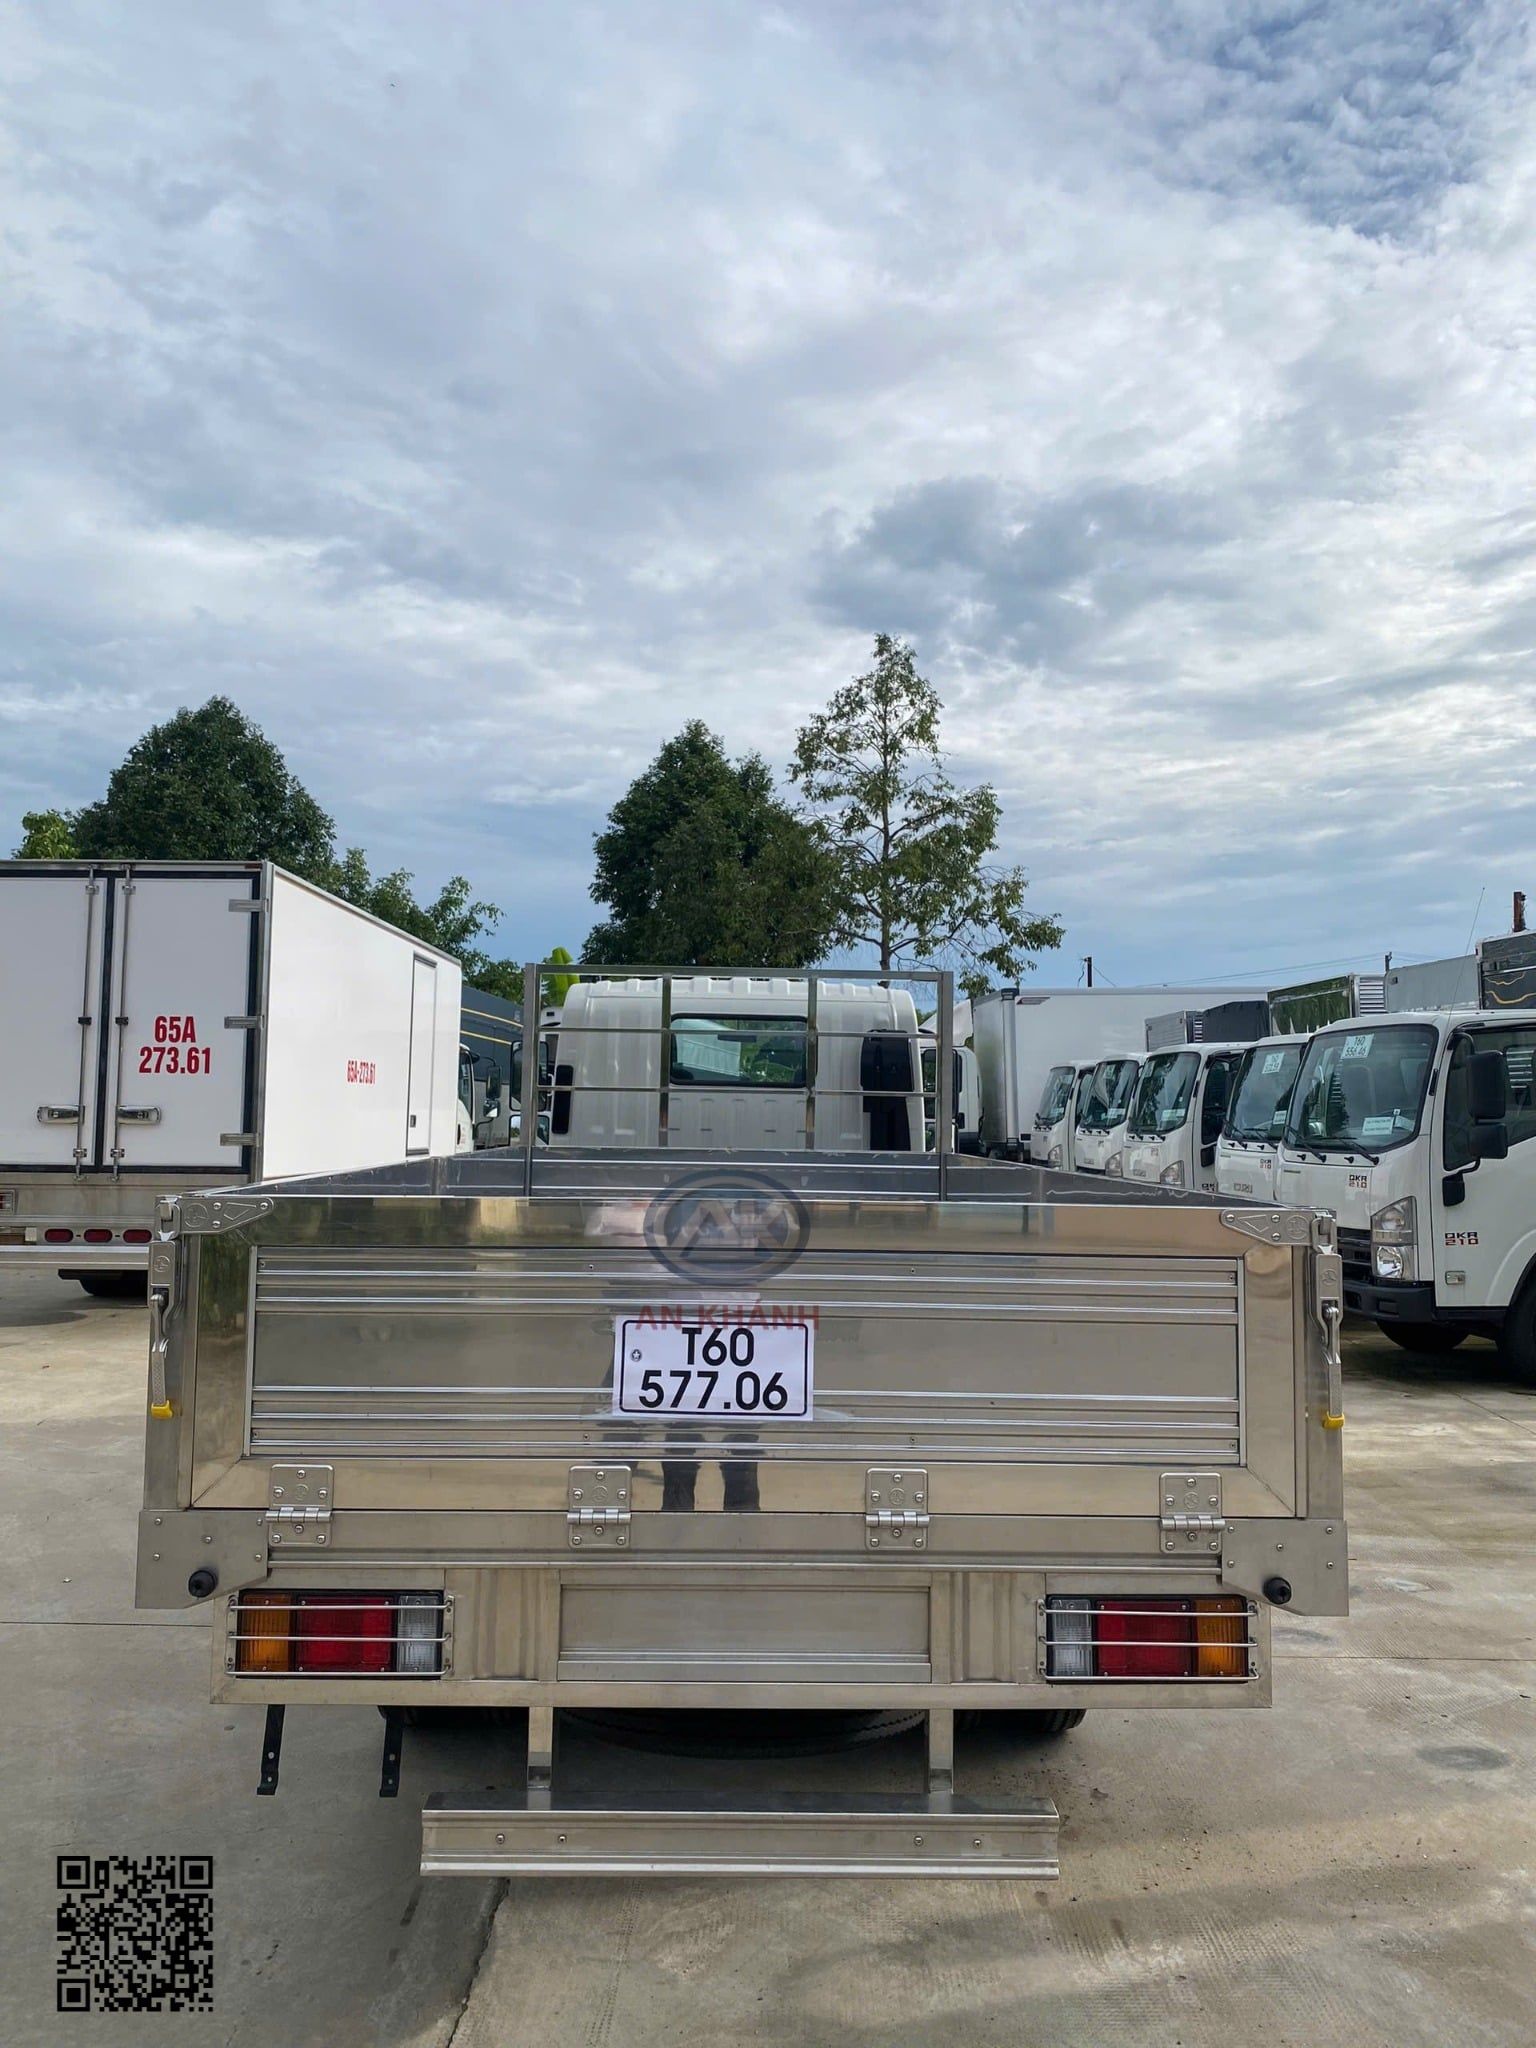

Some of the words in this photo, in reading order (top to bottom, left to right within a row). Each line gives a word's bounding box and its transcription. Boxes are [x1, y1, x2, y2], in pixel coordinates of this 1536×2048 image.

[155, 1015, 196, 1043] 65A
[139, 1046, 211, 1074] 273.61
[1444, 1231, 1478, 1239] QKR
[1444, 1238, 1479, 1246] 210
[681, 1327, 755, 1367] T60
[638, 1369, 789, 1411] 577.06
